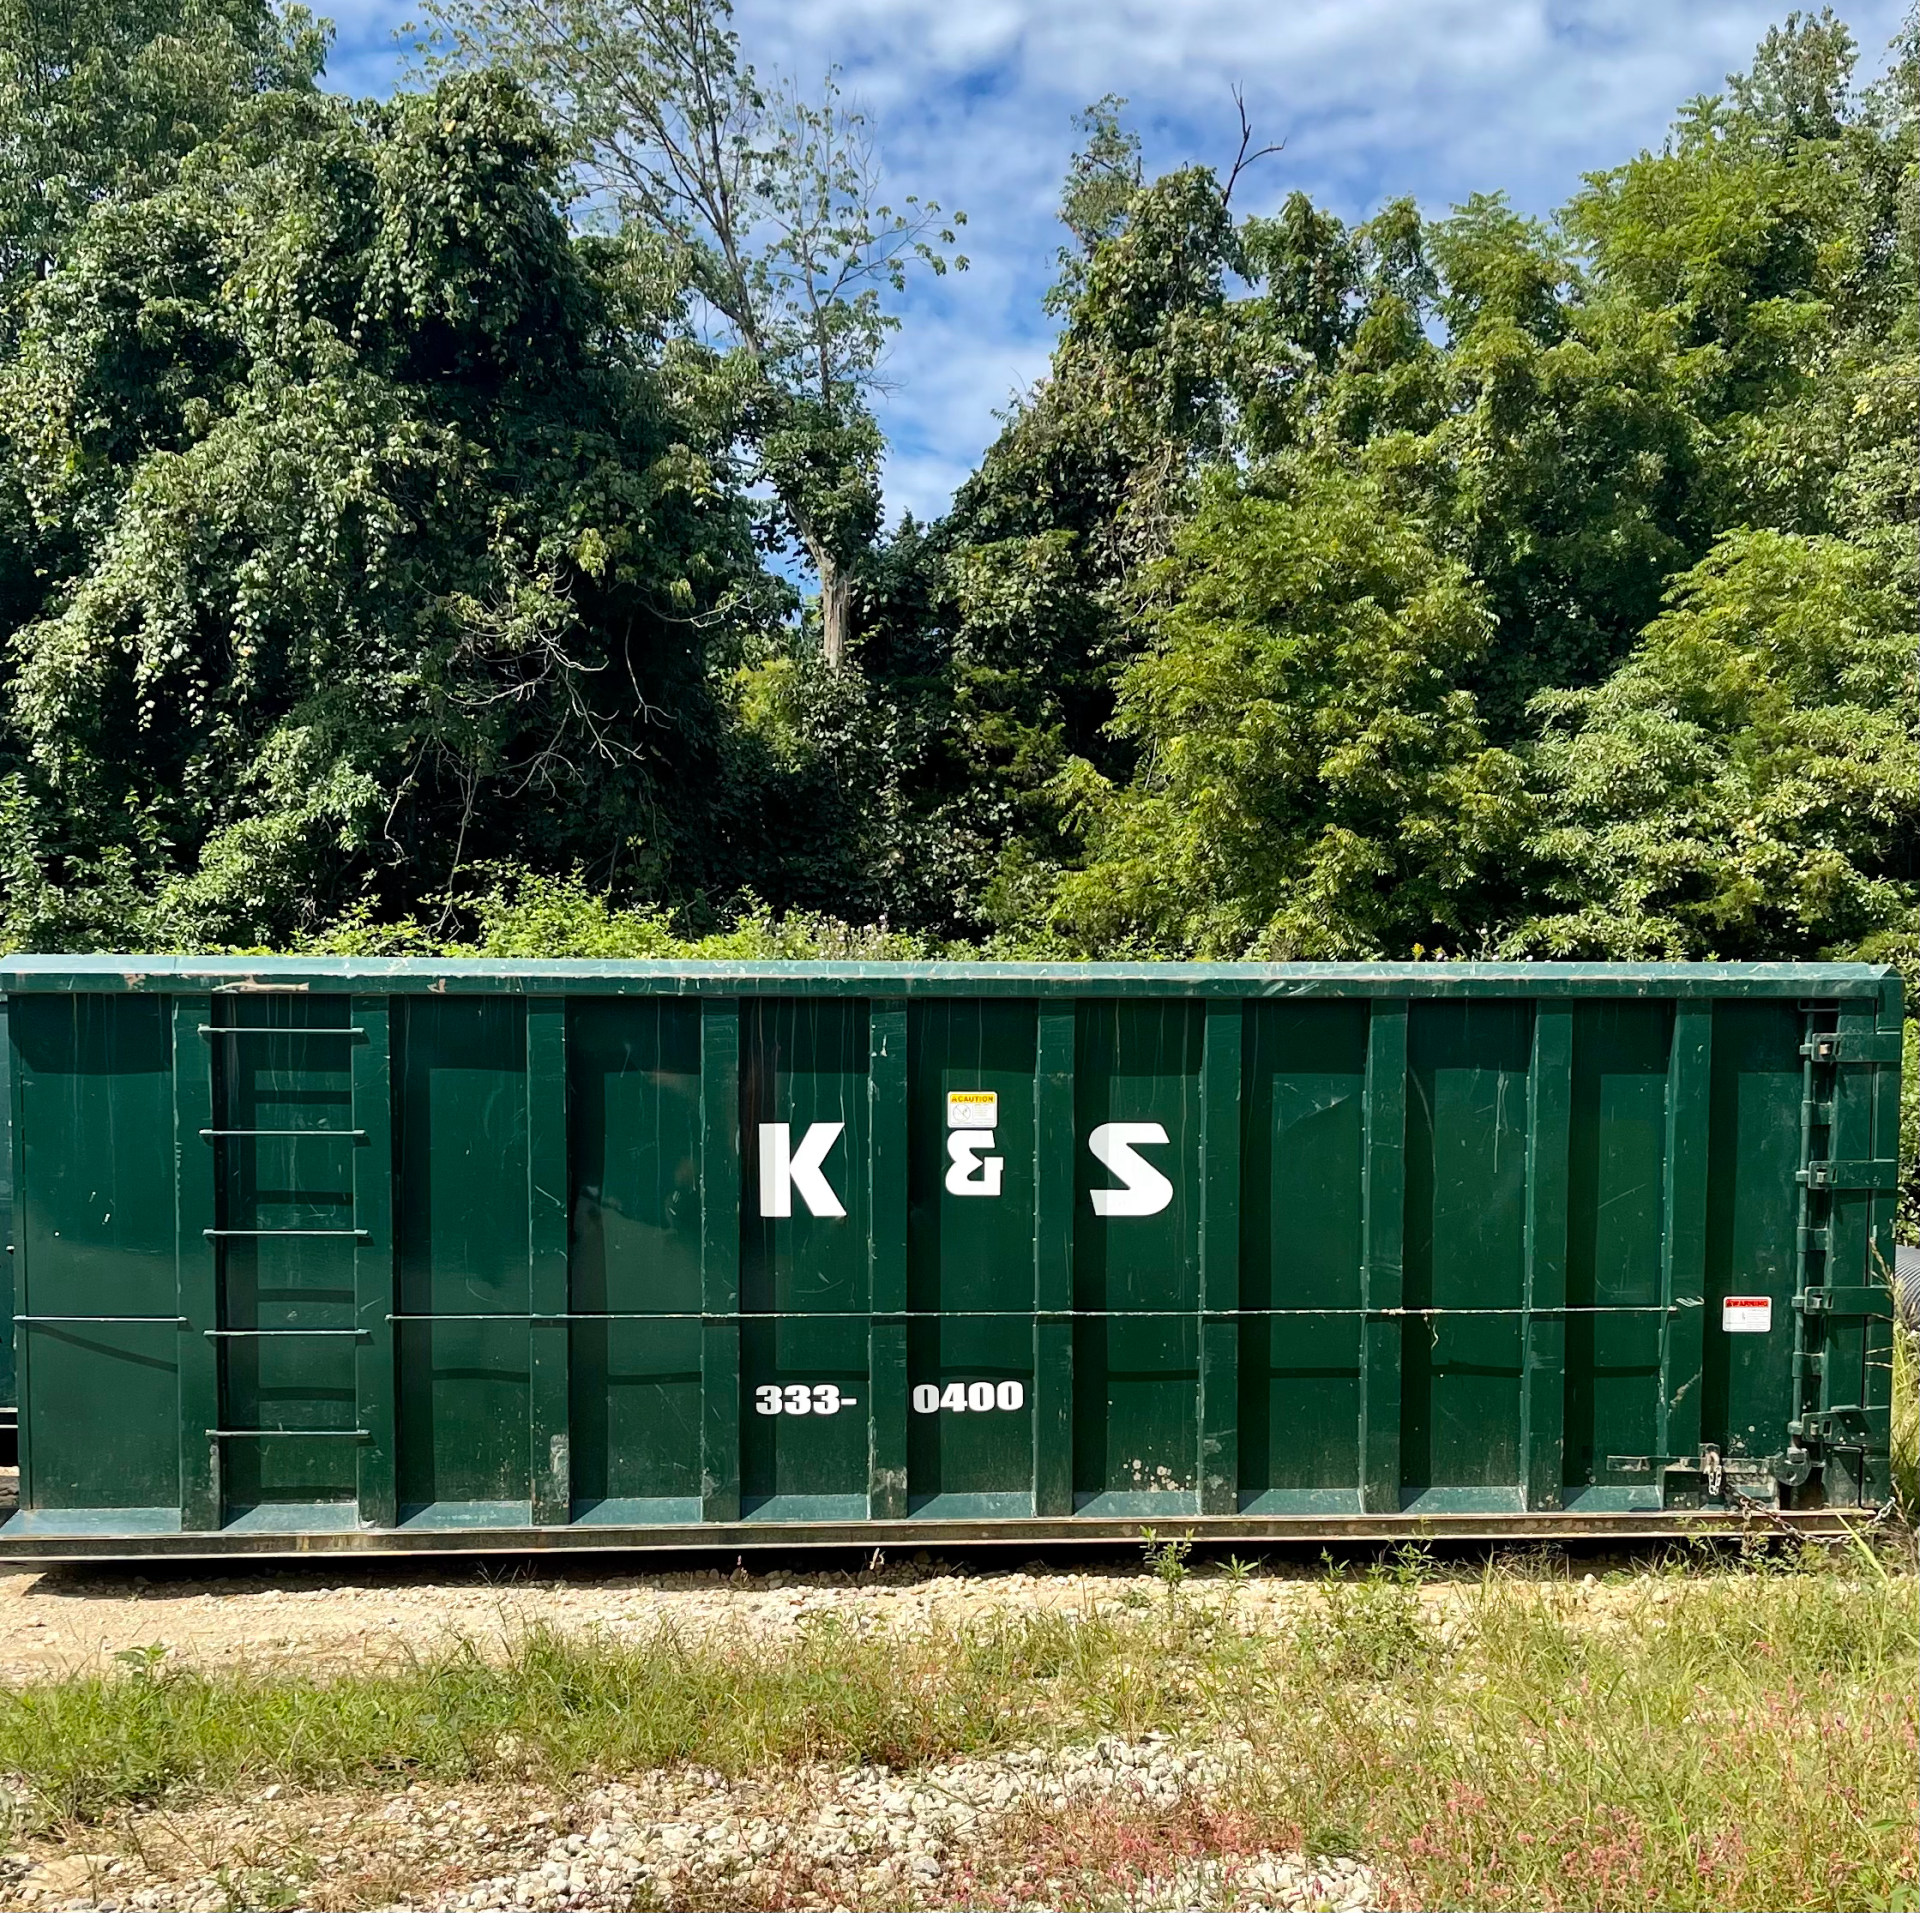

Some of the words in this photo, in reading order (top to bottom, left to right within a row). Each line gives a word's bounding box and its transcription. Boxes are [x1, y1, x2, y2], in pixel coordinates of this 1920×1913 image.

[759, 1122, 846, 1217] K
[945, 1130, 1003, 1195] &
[1089, 1123, 1173, 1216] S
[756, 1385, 856, 1414] 333-
[913, 1381, 1023, 1413] 0400
